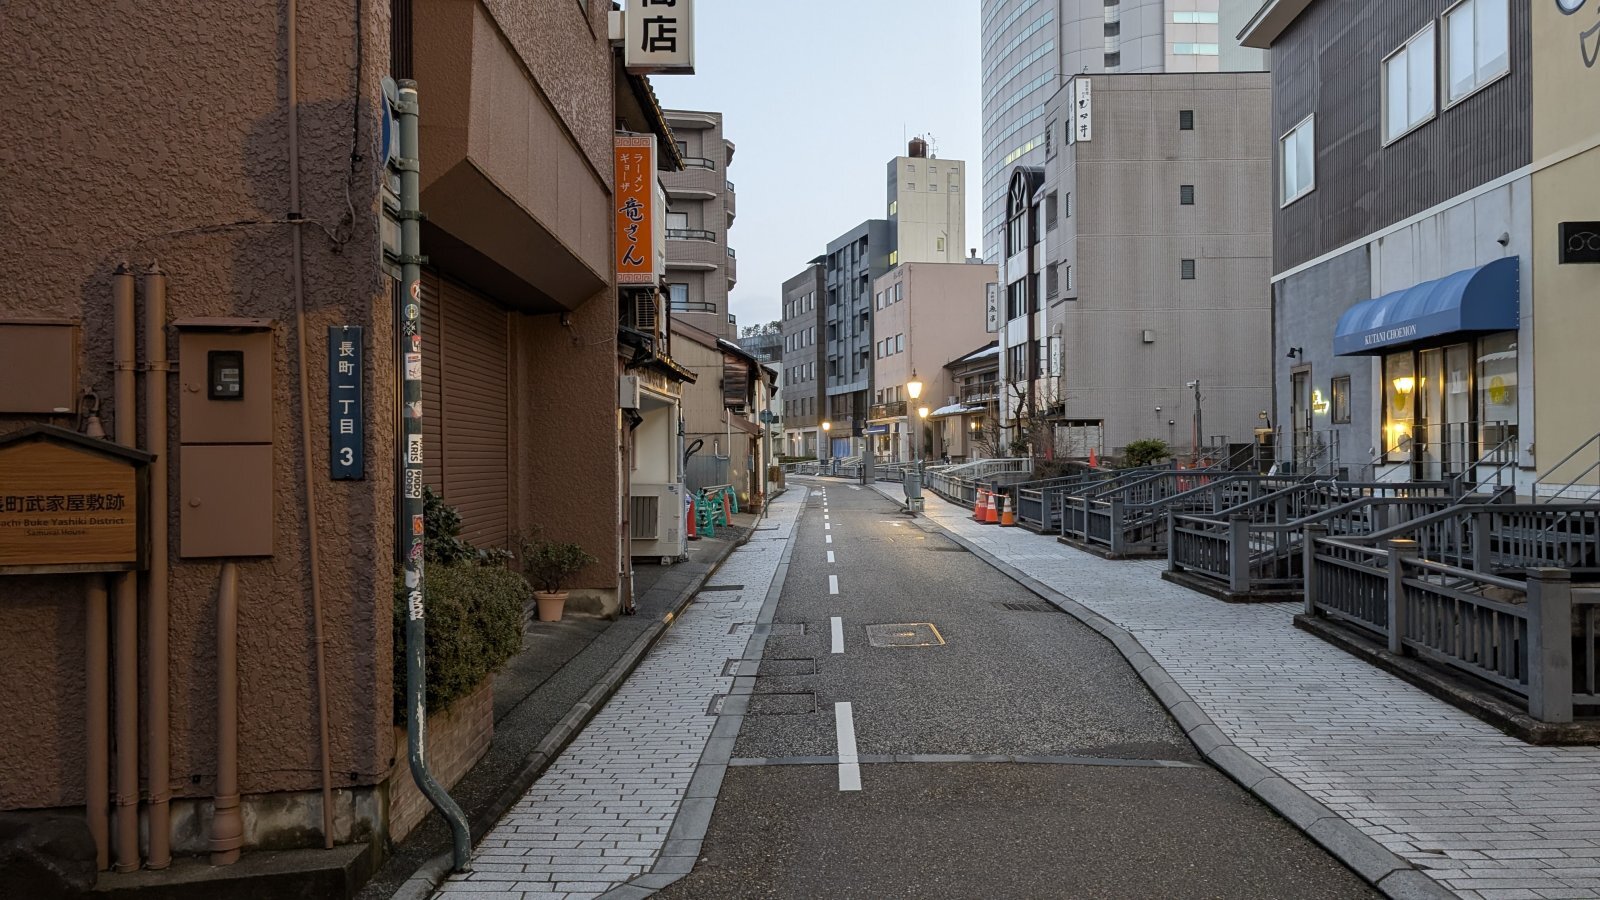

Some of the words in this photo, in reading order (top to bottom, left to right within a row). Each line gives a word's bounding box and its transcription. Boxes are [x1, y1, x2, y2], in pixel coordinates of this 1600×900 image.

[641, 0, 677, 53] 店
[620, 153, 630, 193] ギョーザ
[634, 153, 643, 192] ラーメン
[618, 197, 644, 266] 竜さん
[1364, 331, 1386, 345] KUTANI
[1386, 324, 1416, 340] CHOEMON
[338, 341, 355, 434] 長町一丁目
[339, 447, 354, 466] 3
[410, 440, 418, 462] KRIS
[0, 494, 125, 512] 町武家屋敷跡
[24, 519, 48, 527] Buke
[52, 517, 87, 526] Yashiki
[89, 517, 125, 525] District
